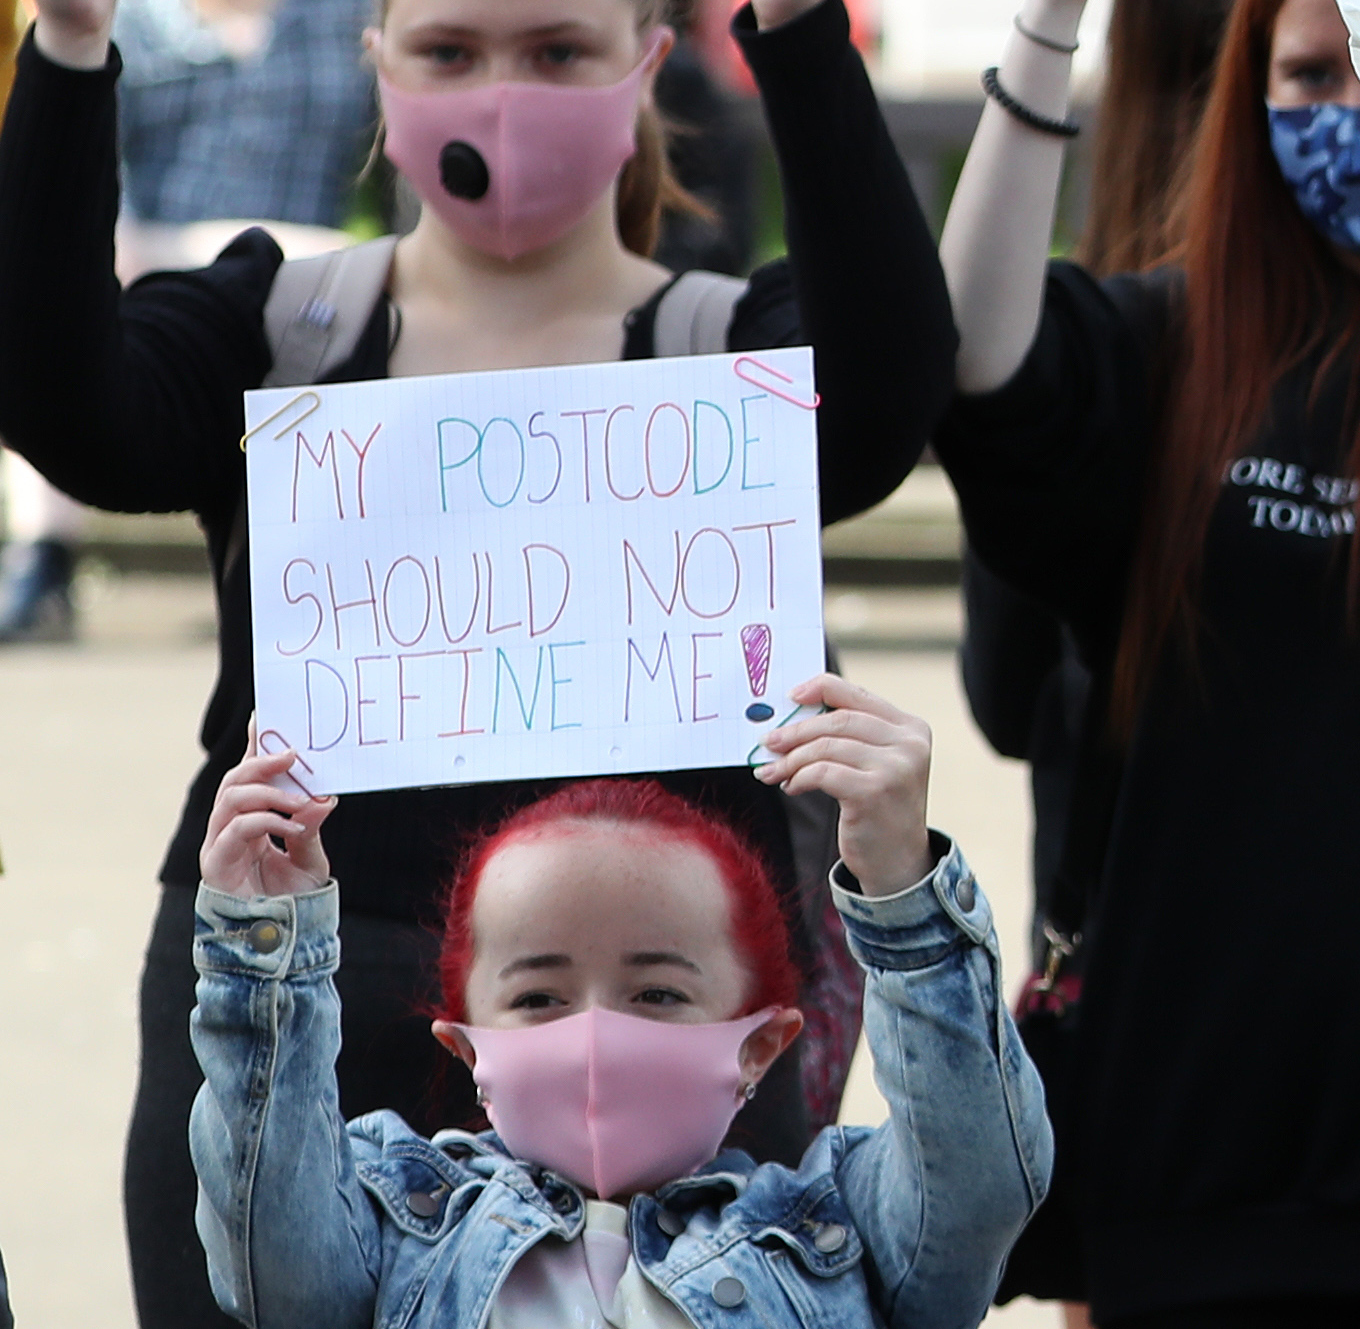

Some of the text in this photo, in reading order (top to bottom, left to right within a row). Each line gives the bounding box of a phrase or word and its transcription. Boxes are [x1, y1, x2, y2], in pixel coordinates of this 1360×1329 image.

[290, 393, 775, 523] MY POSTCODE
[1221, 456, 1307, 497] ORE
[275, 519, 796, 655] SHOULD NOT
[305, 641, 586, 752] DEFINE
